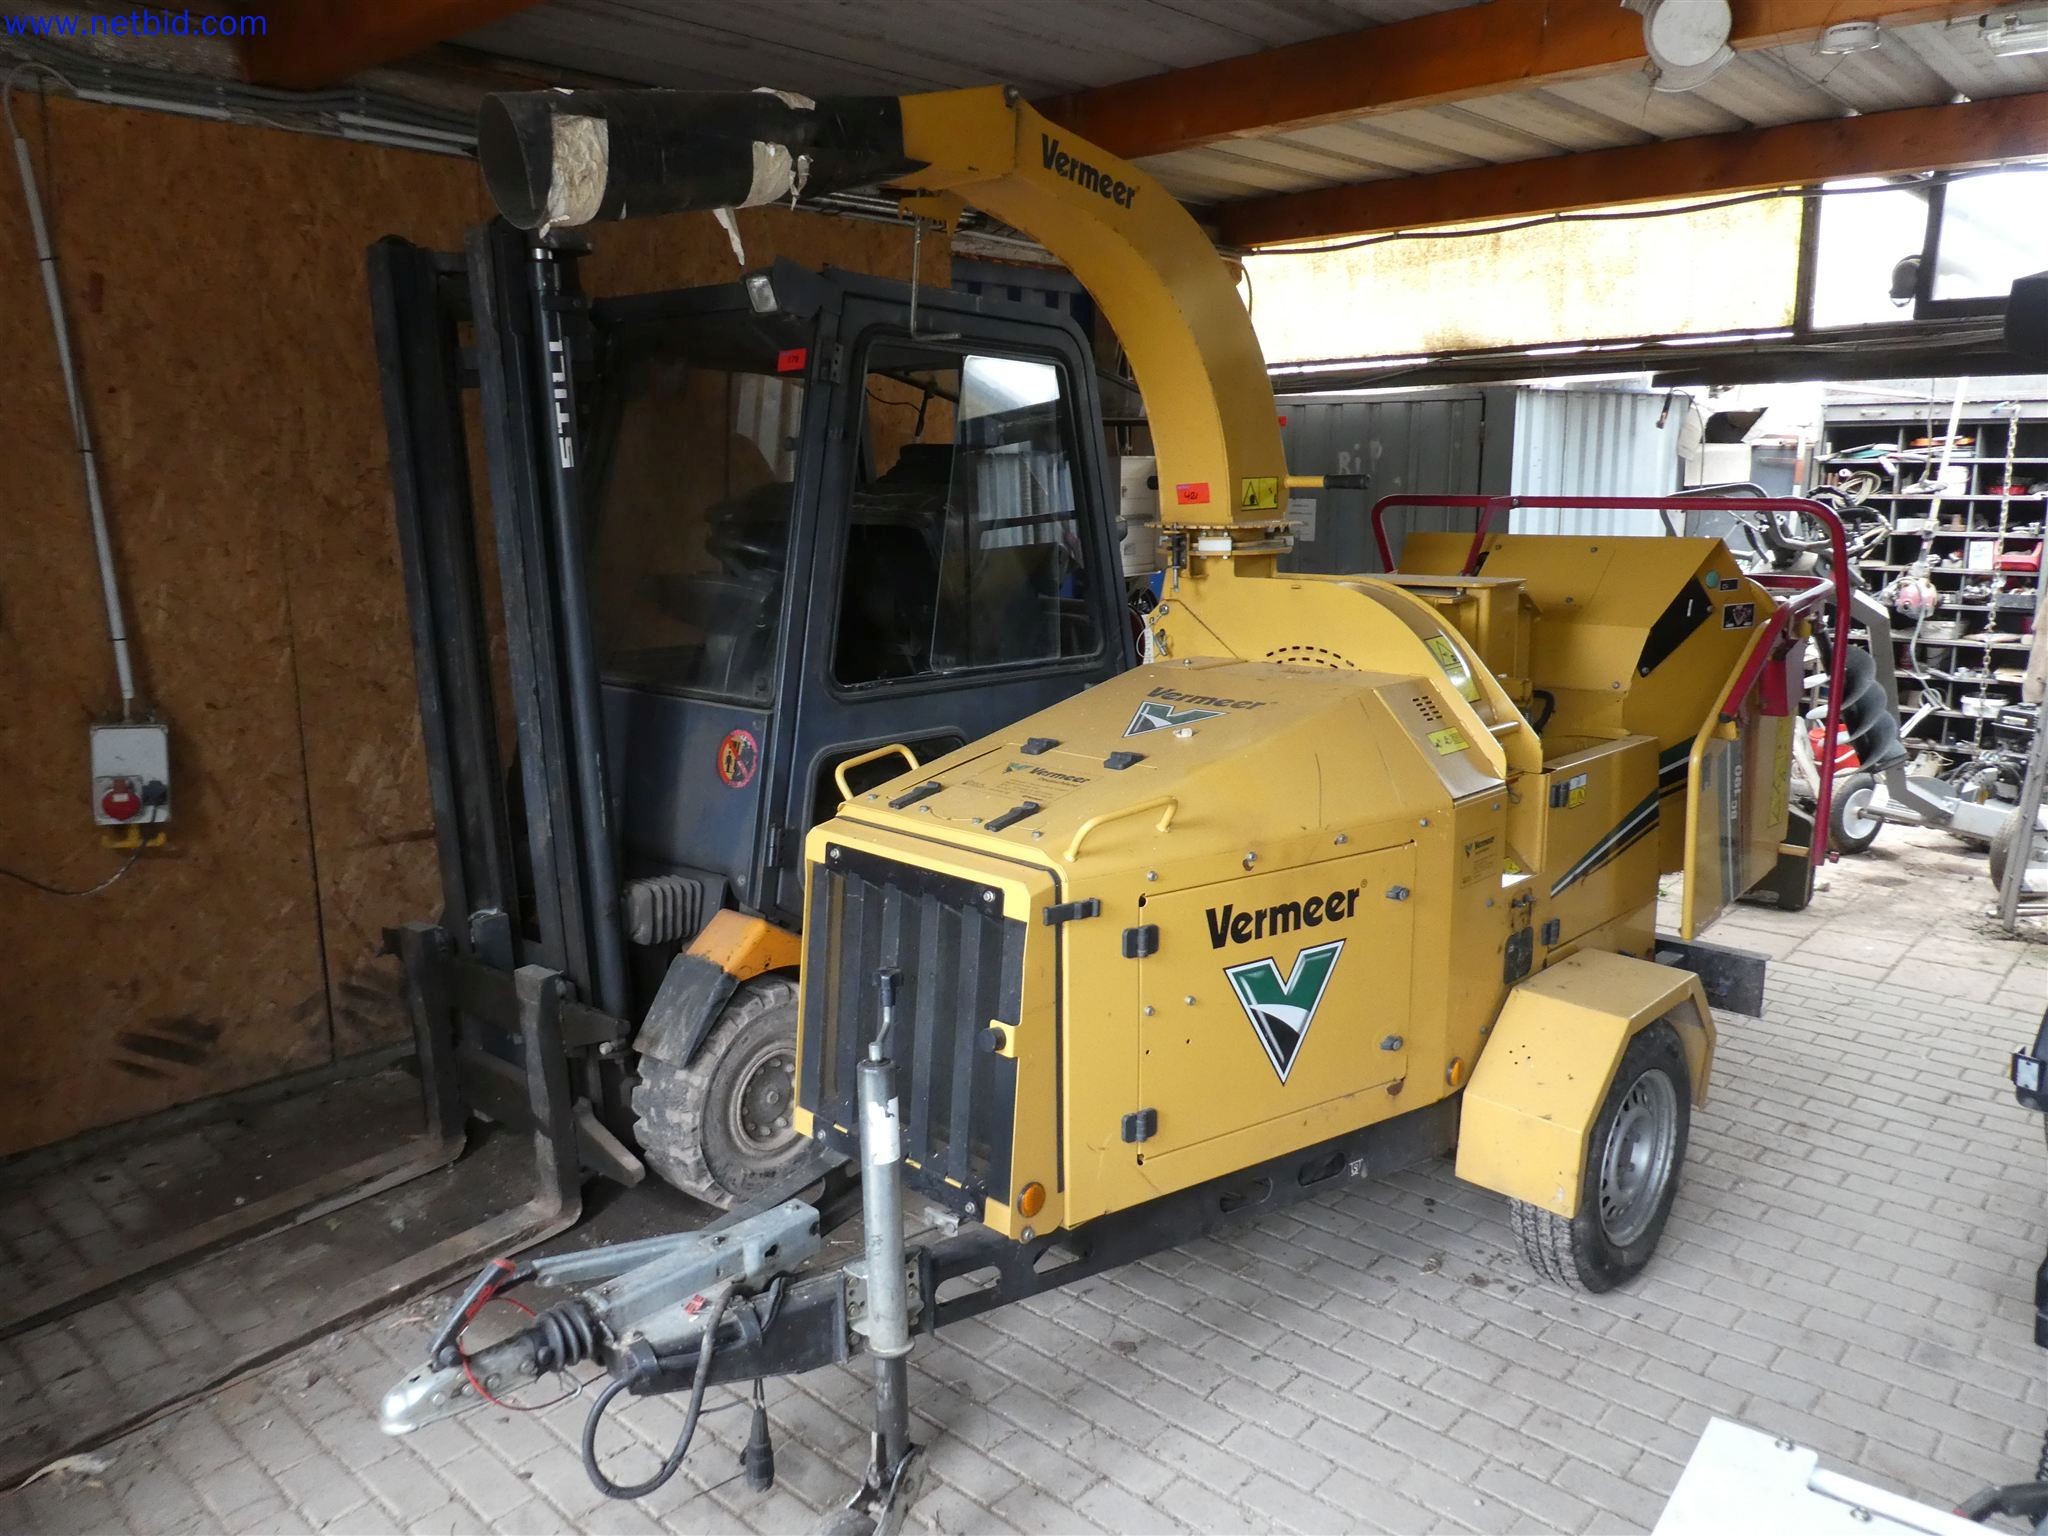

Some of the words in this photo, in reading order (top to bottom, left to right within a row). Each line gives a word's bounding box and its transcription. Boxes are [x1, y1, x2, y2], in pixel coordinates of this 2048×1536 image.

[1041, 132, 1135, 210] Vermeer
[1147, 686, 1267, 710] Vermeer
[1029, 766, 1091, 784] Vermeer
[1205, 887, 1360, 950] Vermeer
